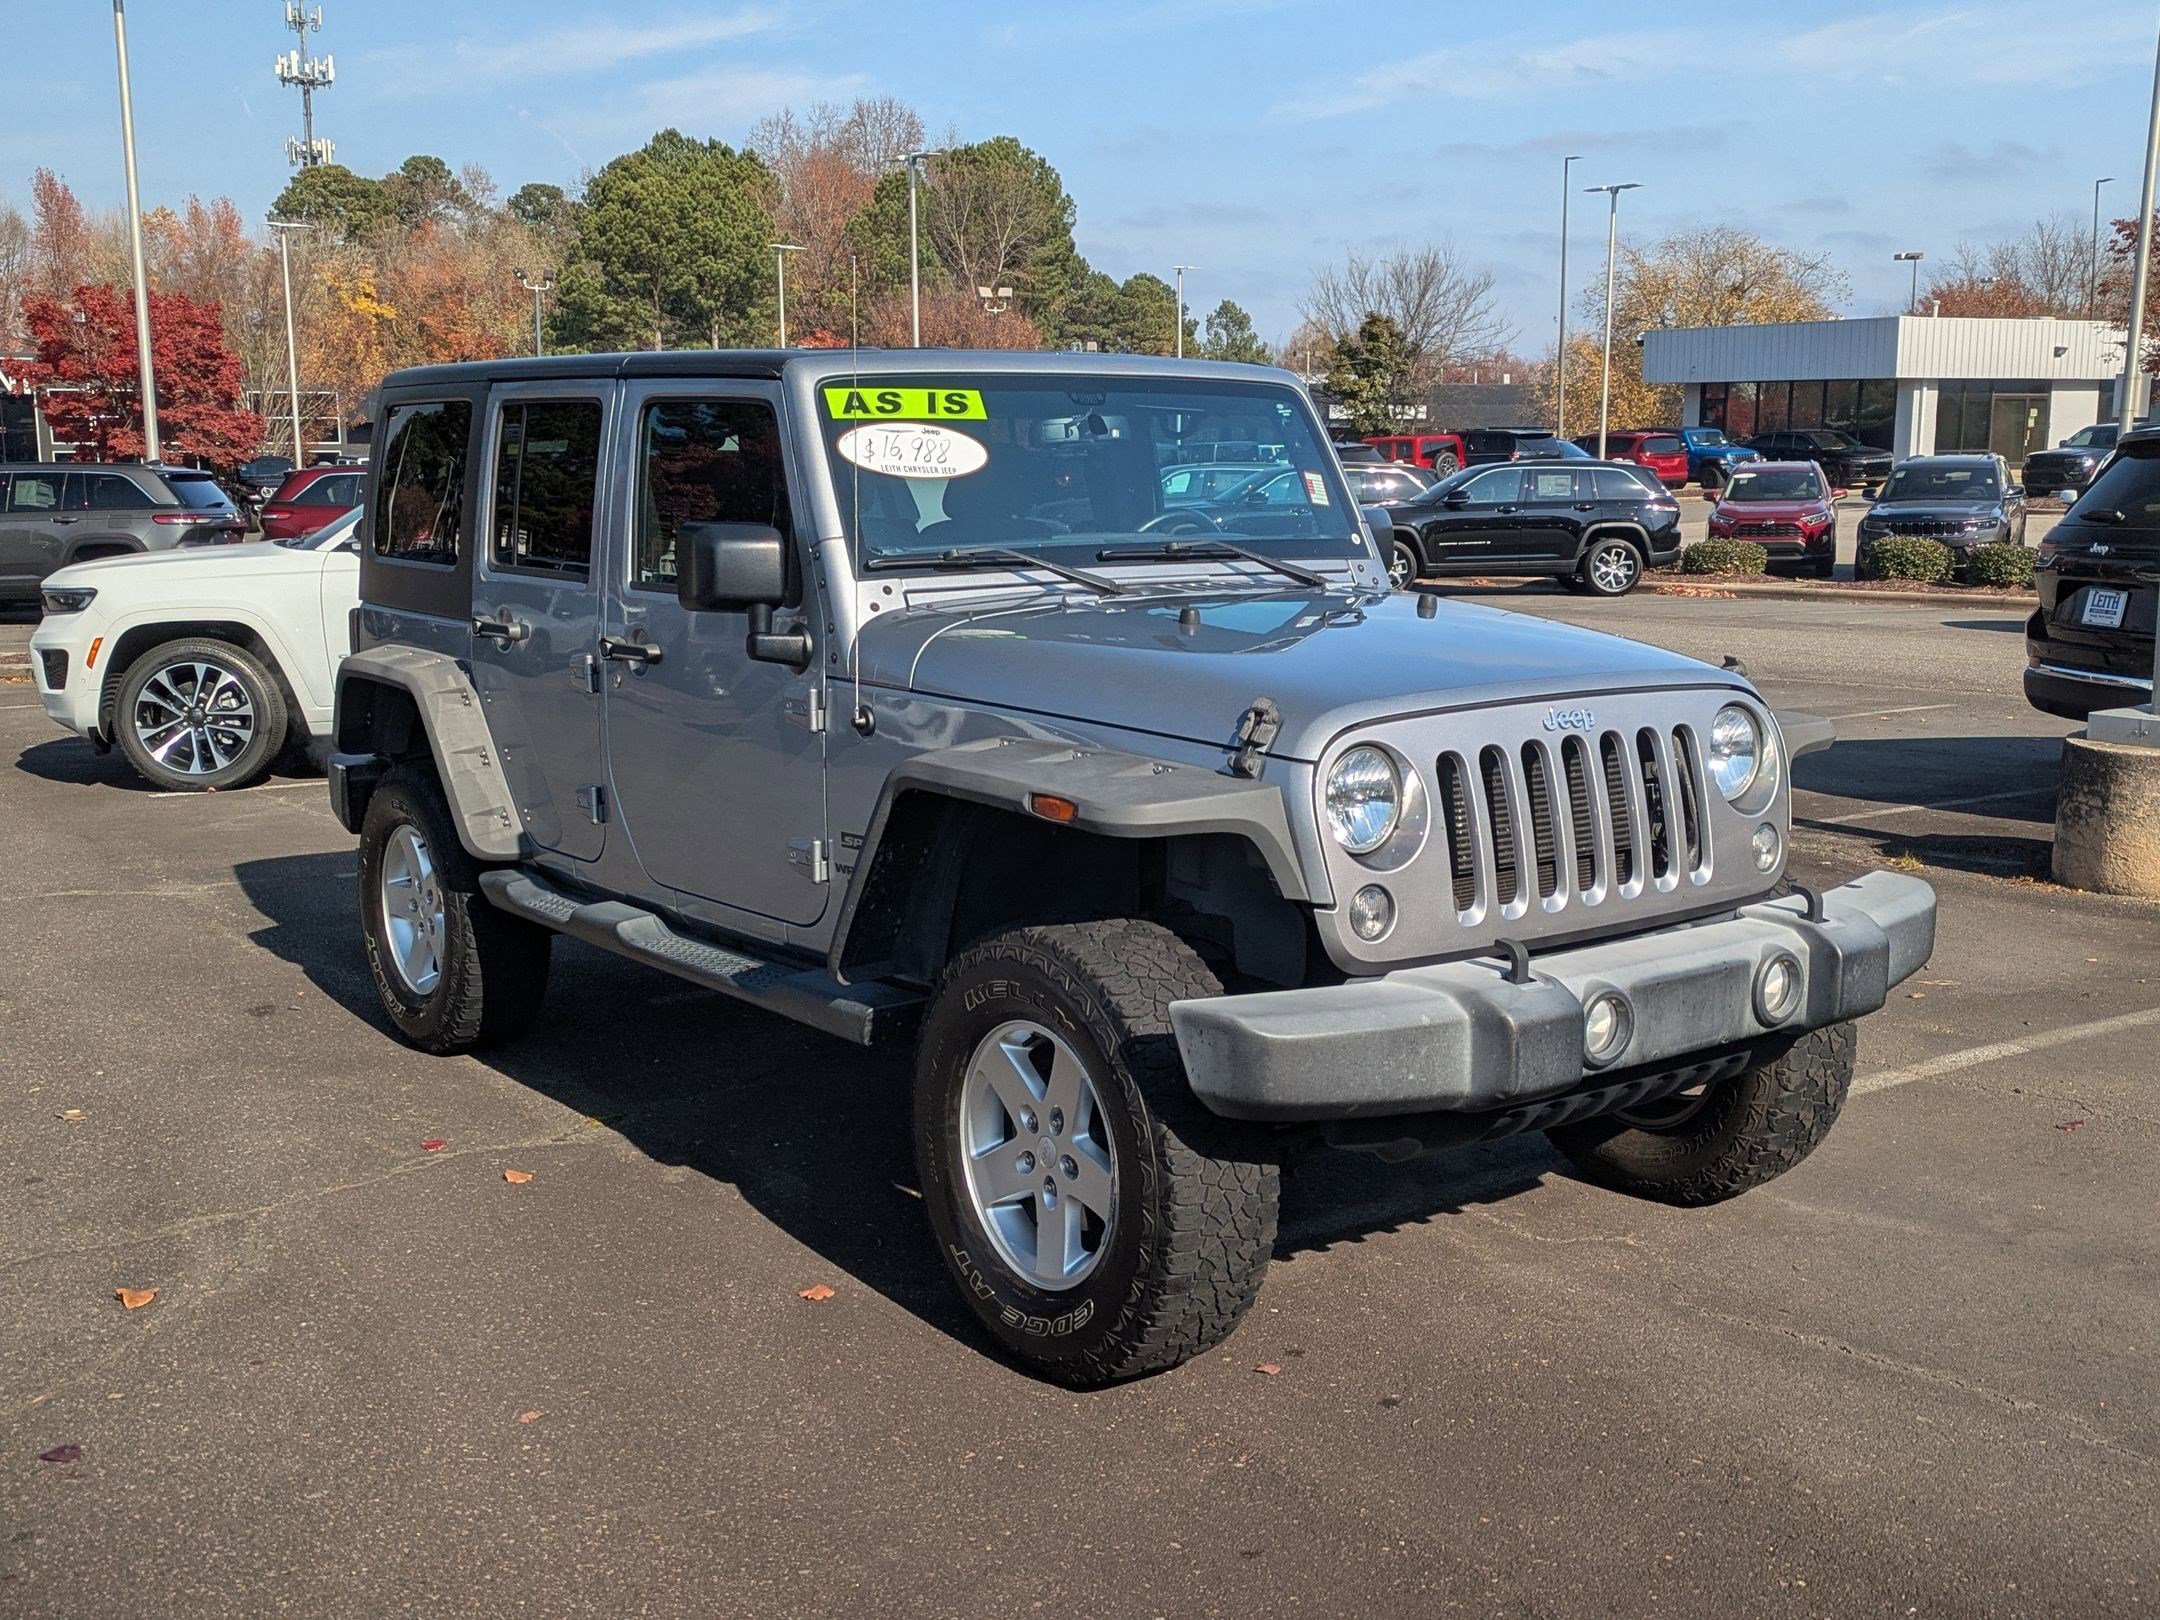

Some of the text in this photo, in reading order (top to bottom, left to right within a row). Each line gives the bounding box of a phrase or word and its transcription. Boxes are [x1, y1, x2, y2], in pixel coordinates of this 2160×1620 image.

[842, 391, 969, 415] AS IS
[921, 427, 940, 436] Jeep
[880, 464, 957, 475] LEITH CHRYSLER JEEP
[2090, 542, 2109, 555] Jeep
[2091, 590, 2121, 610] LEITH
[1542, 706, 1597, 732] Jeep
[964, 979, 1076, 1032] KELLY
[1000, 1298, 1095, 1337] EDGE
